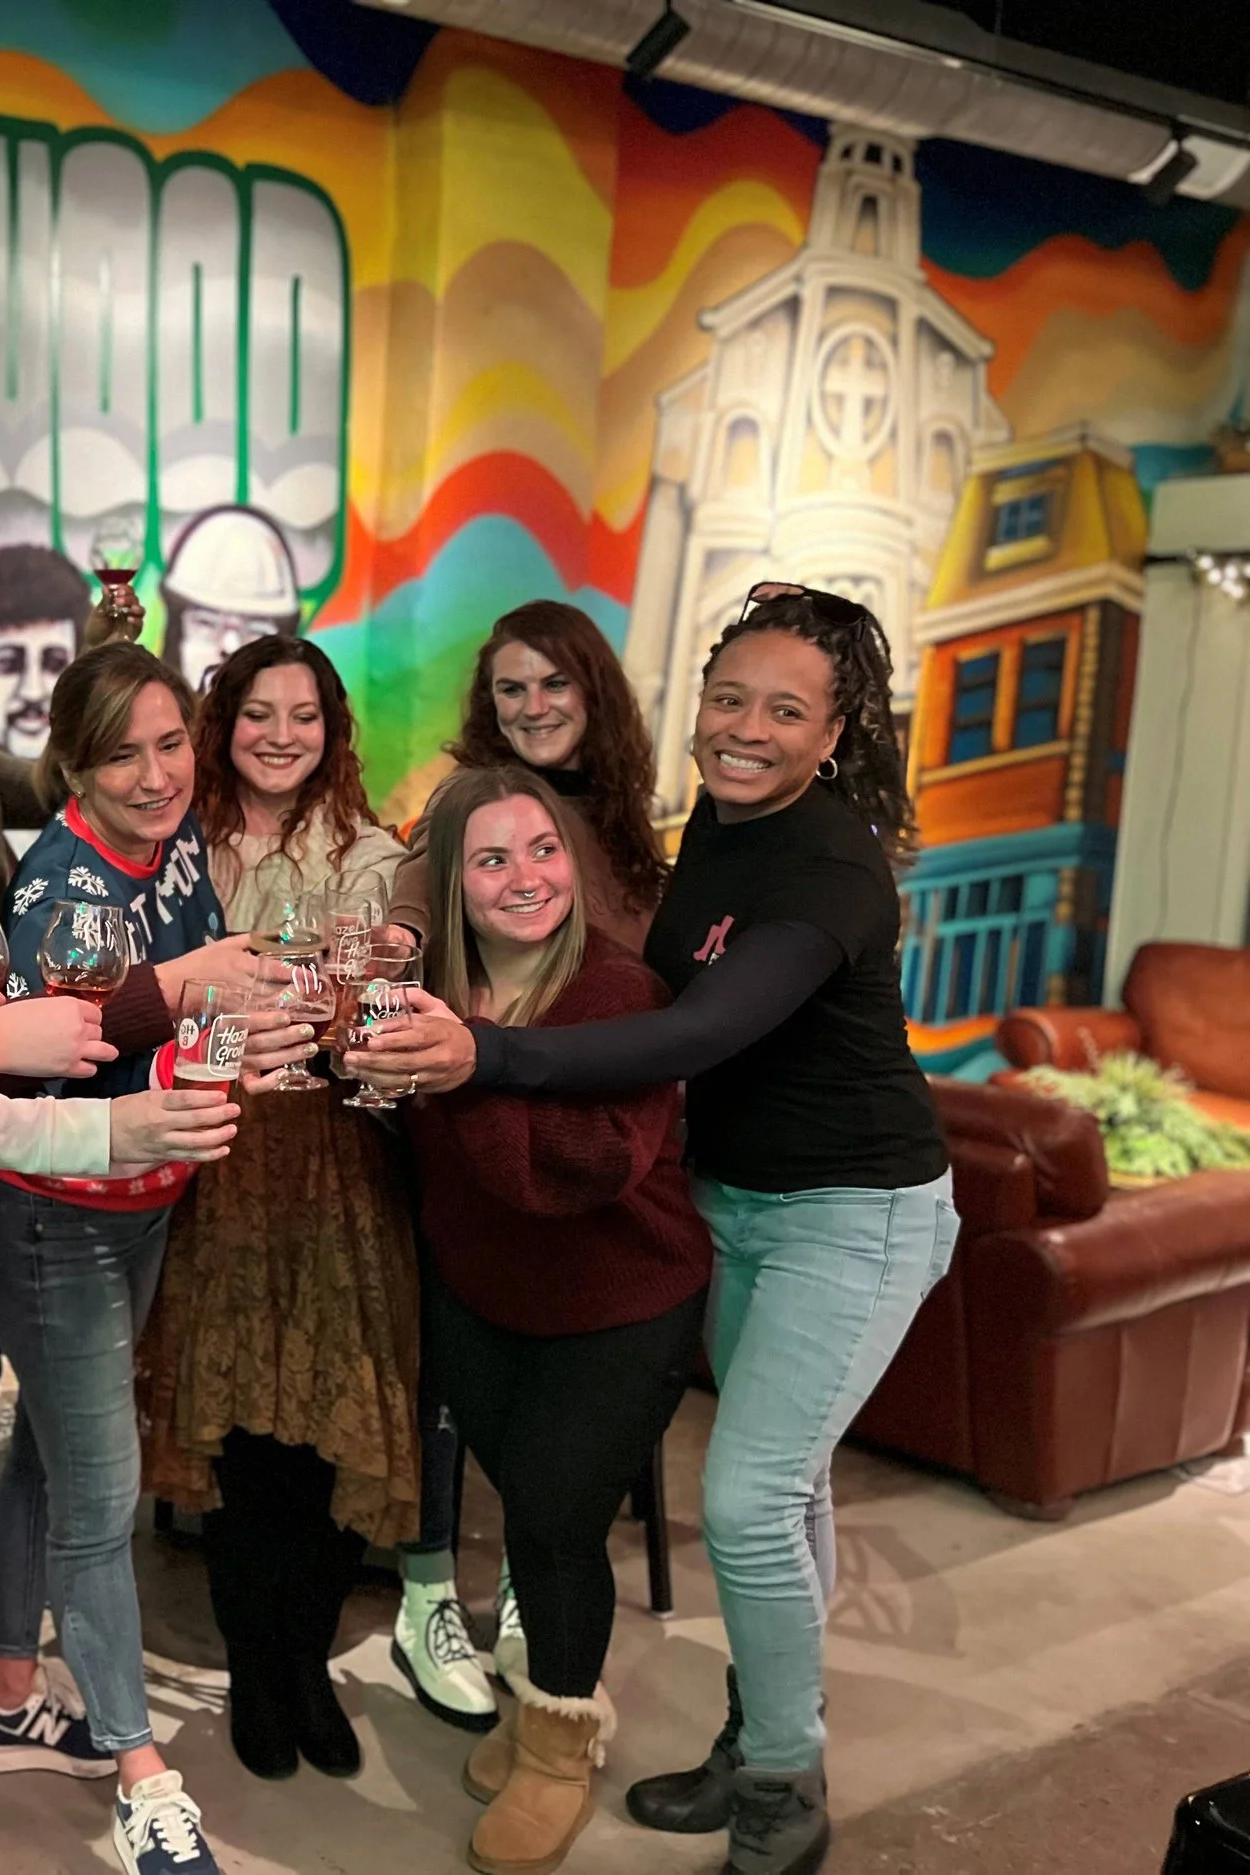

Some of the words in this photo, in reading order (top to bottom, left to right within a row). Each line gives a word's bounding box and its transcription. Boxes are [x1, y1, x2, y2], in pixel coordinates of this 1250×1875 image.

[217, 1025, 249, 1045] Haz
[216, 1043, 246, 1069] Grov
[28, 1711, 71, 1746] N
